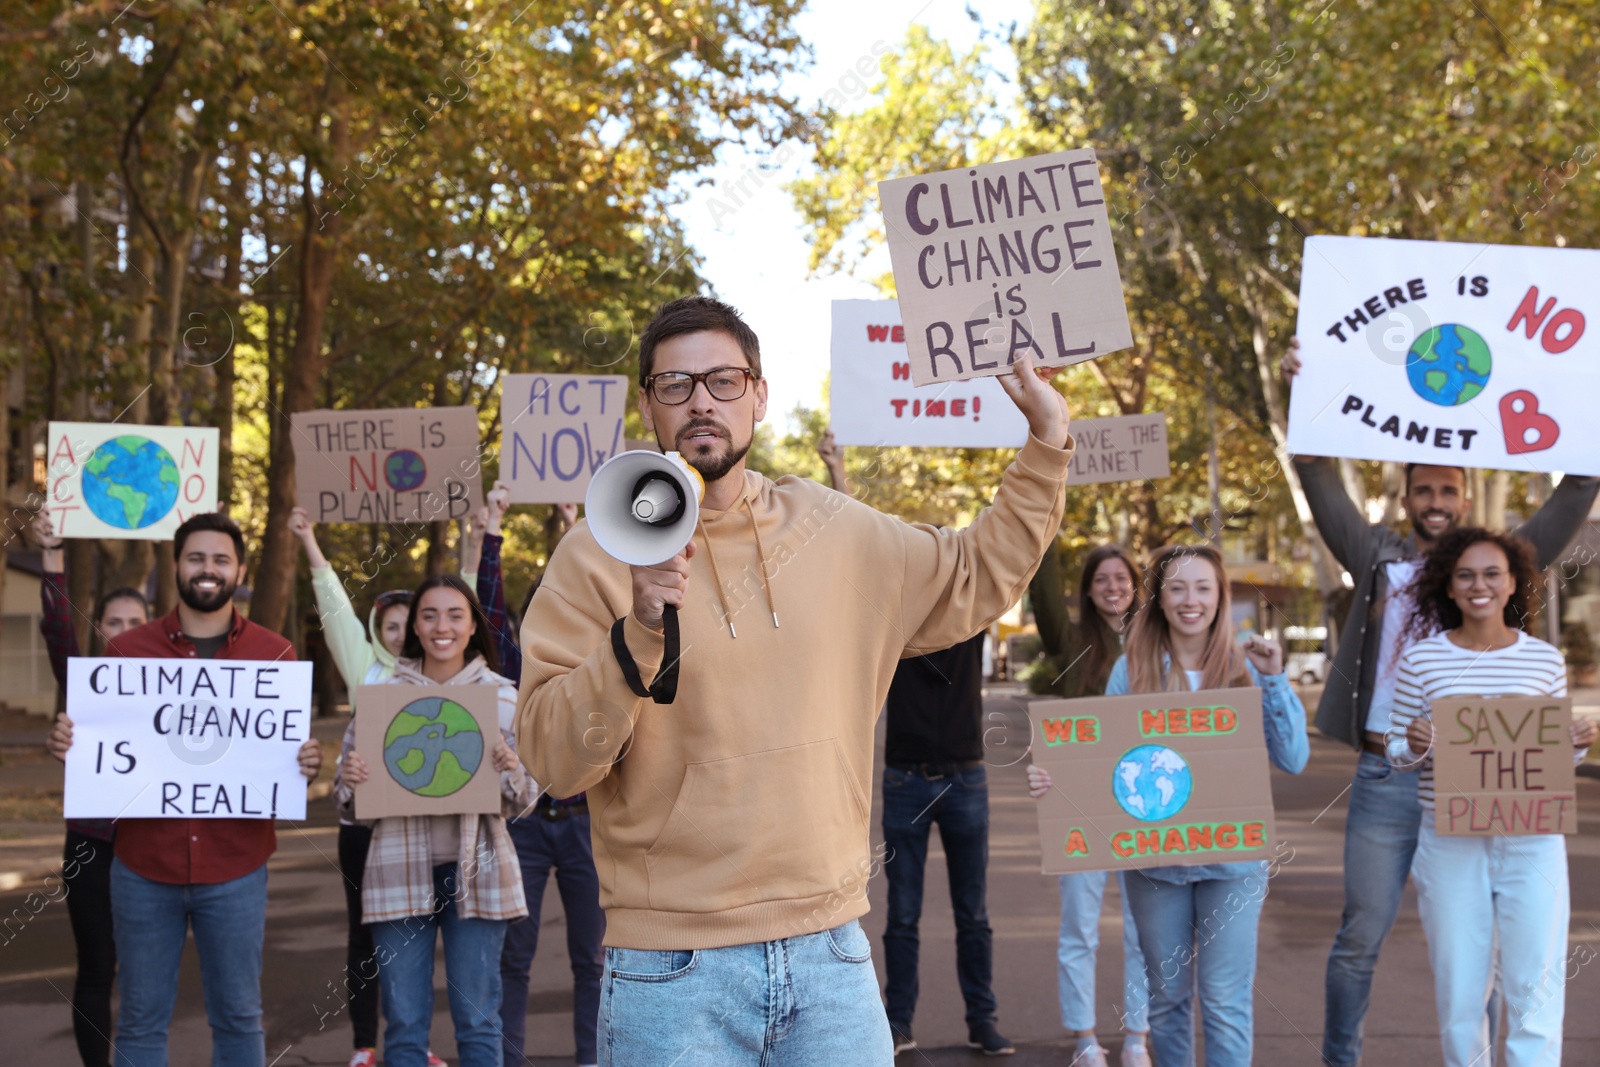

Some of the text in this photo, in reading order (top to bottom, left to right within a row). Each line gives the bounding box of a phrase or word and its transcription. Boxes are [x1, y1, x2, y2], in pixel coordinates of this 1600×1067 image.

[918, 219, 1102, 290] CHANGE
[1326, 275, 1490, 343] THERE IS
[1506, 285, 1586, 354] NO
[925, 311, 1096, 378] REAL
[529, 376, 618, 416] ACT
[890, 396, 982, 423] TIME!
[307, 419, 397, 453] THERE
[1075, 423, 1160, 450] AVE THE
[1341, 394, 1479, 452] PLANET
[1498, 389, 1560, 455] B
[319, 481, 471, 522] PLANET B
[88, 663, 281, 699] CLIMATE
[153, 703, 303, 742] CHANGE
[1041, 706, 1238, 744] WE NEED
[1449, 705, 1561, 746] SAVE
[96, 740, 137, 775] IS
[1470, 748, 1546, 791] THE
[161, 782, 279, 819] REAL!
[1448, 795, 1574, 833] PLANET
[1064, 822, 1266, 858] A CHANGE
